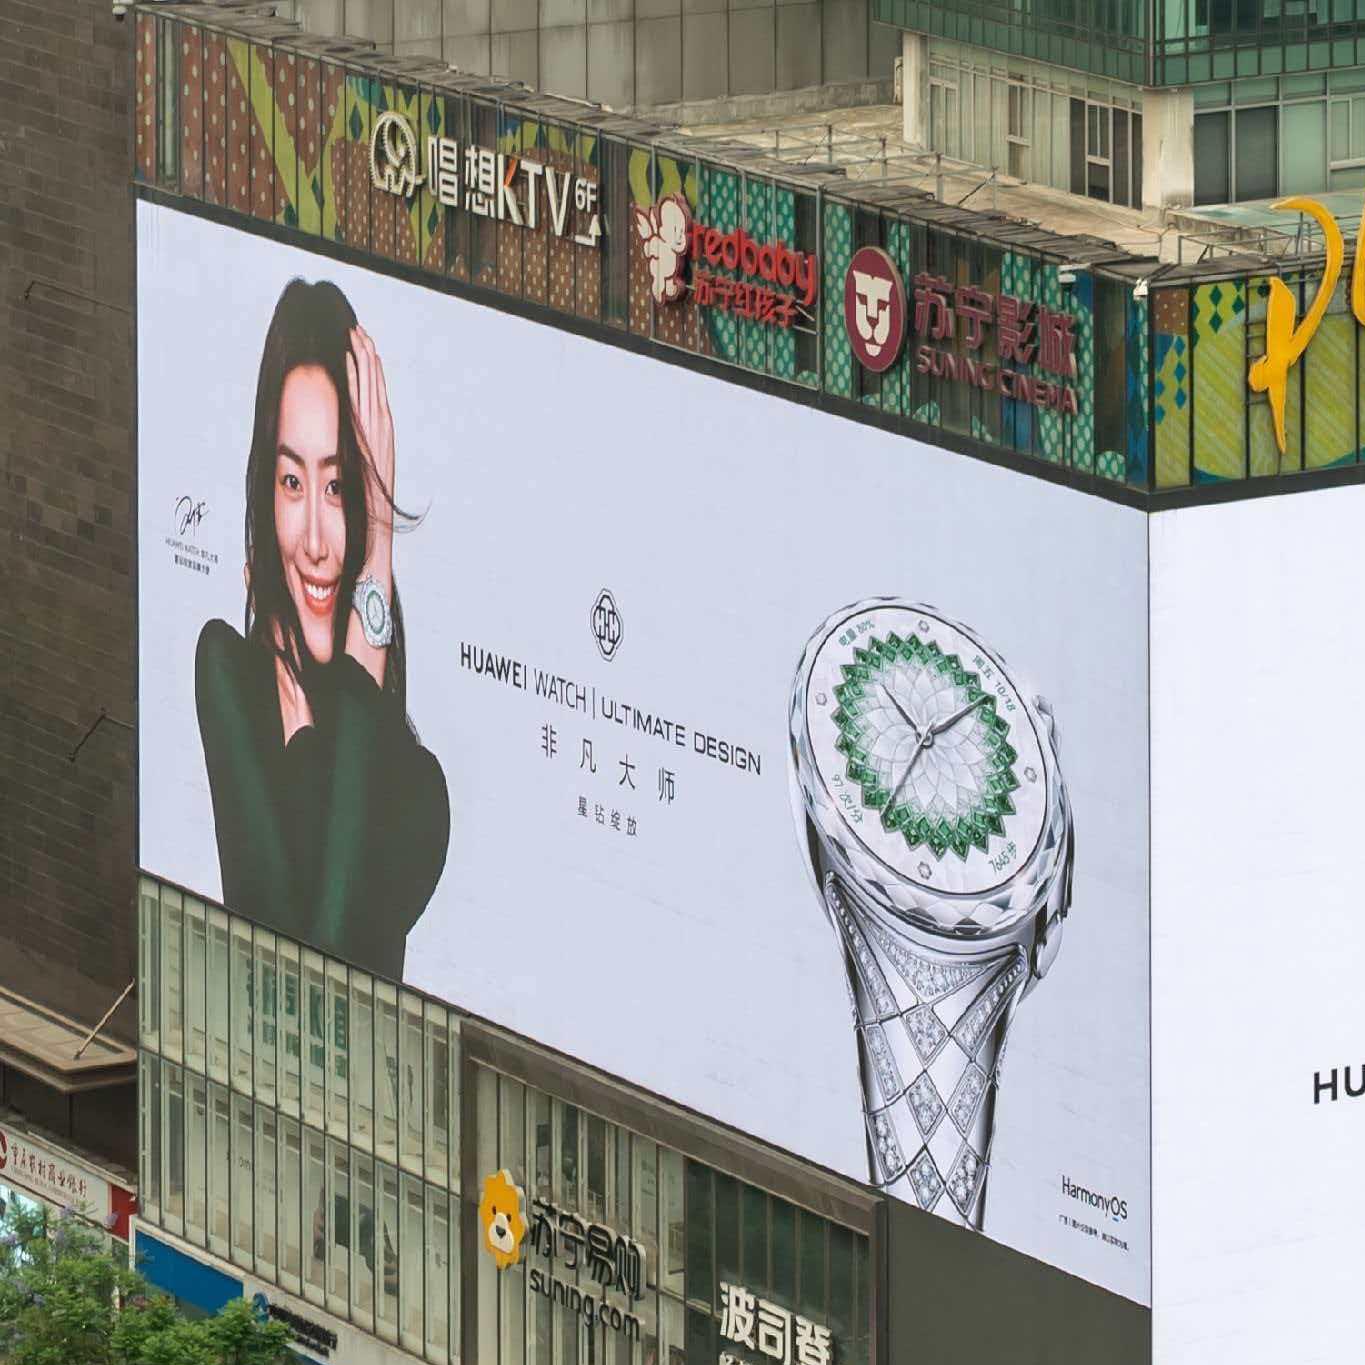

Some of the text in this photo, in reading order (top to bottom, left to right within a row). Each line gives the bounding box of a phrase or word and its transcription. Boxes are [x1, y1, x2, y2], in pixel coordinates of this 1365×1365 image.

[574, 179, 598, 211] 6F
[688, 221, 818, 306] redbaby
[912, 271, 1078, 379] 苏宁影城
[916, 345, 1079, 415] SUNING CINEMA
[460, 642, 761, 775] HUAWEI WATCH ULTIMATE DESIGN
[541, 720, 676, 804] 非凡大师
[1061, 1174, 1128, 1220] HarmonyOS
[529, 1199, 646, 1300] 苏宁易购
[529, 1267, 640, 1342] suning.com
